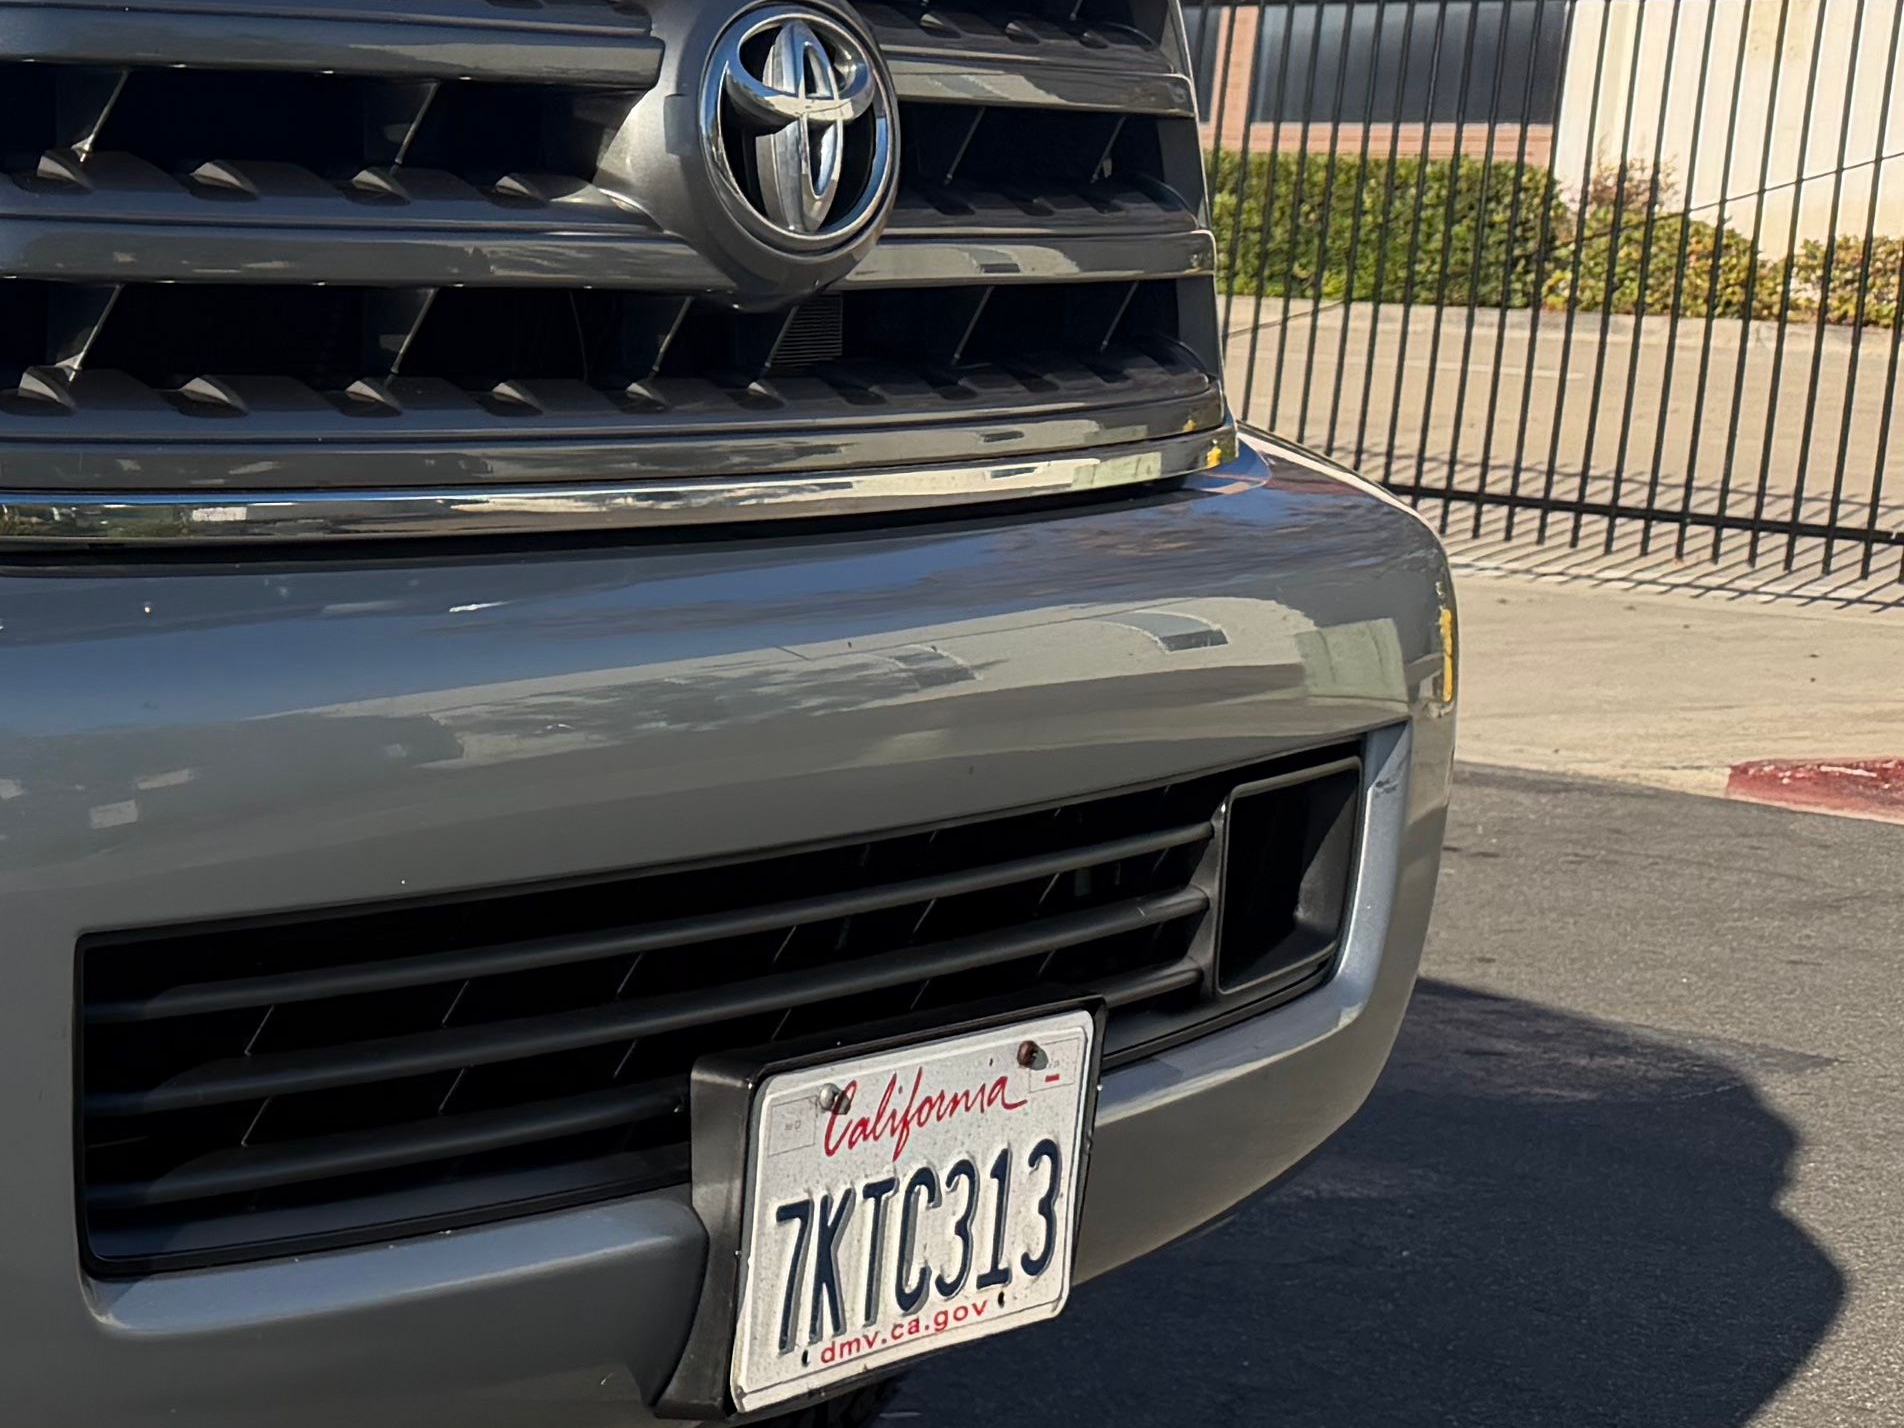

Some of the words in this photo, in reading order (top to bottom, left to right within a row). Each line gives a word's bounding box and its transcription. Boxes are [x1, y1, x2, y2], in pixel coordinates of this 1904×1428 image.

[823, 1066, 1029, 1162] California
[776, 1138, 1061, 1354] 7KTC313
[819, 1298, 989, 1364] dmv.ca.gov
